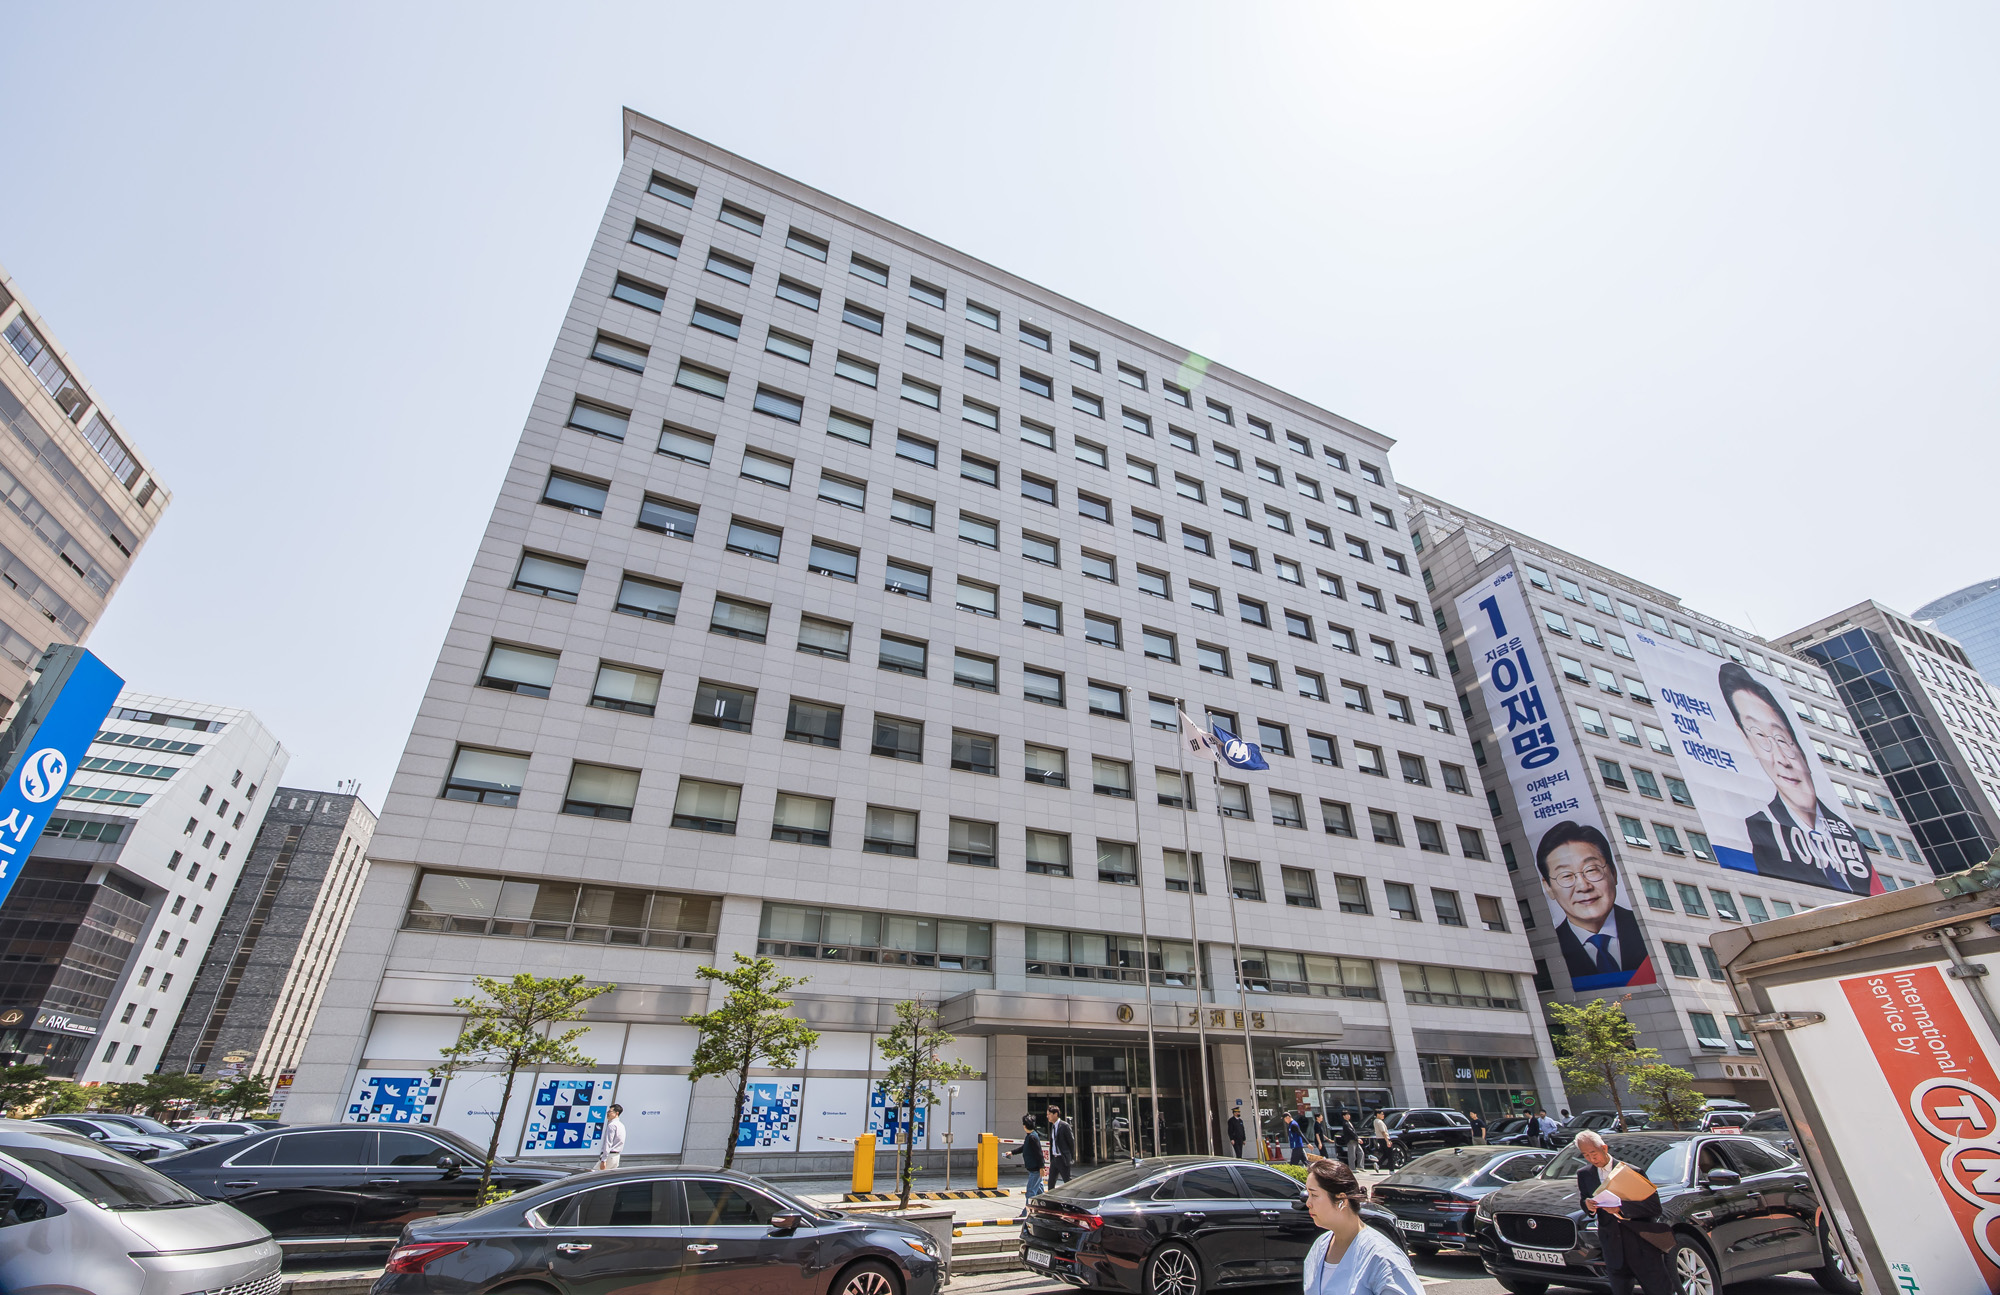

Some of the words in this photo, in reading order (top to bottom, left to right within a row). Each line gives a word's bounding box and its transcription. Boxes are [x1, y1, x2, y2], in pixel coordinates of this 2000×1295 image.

[1478, 594, 1508, 640] 1
[1484, 637, 1522, 663] 지금은
[1491, 647, 1560, 769] 이재명
[1661, 688, 1717, 721] 이제부터
[1671, 713, 1703, 739] 진짜
[1682, 740, 1738, 773] 대한민국
[1526, 770, 1570, 792] 이제부터
[1530, 791, 1552, 807] 진짜
[1534, 798, 1579, 819] 대한민국
[1819, 817, 1852, 837] 지금은
[46, 1015, 71, 1029] ARK
[1868, 978, 1907, 1032] service
[1894, 1036, 1920, 1055] by
[1893, 973, 1967, 1073] International
[1286, 1057, 1305, 1069] dope
[1536, 1252, 1560, 1263] 9152
